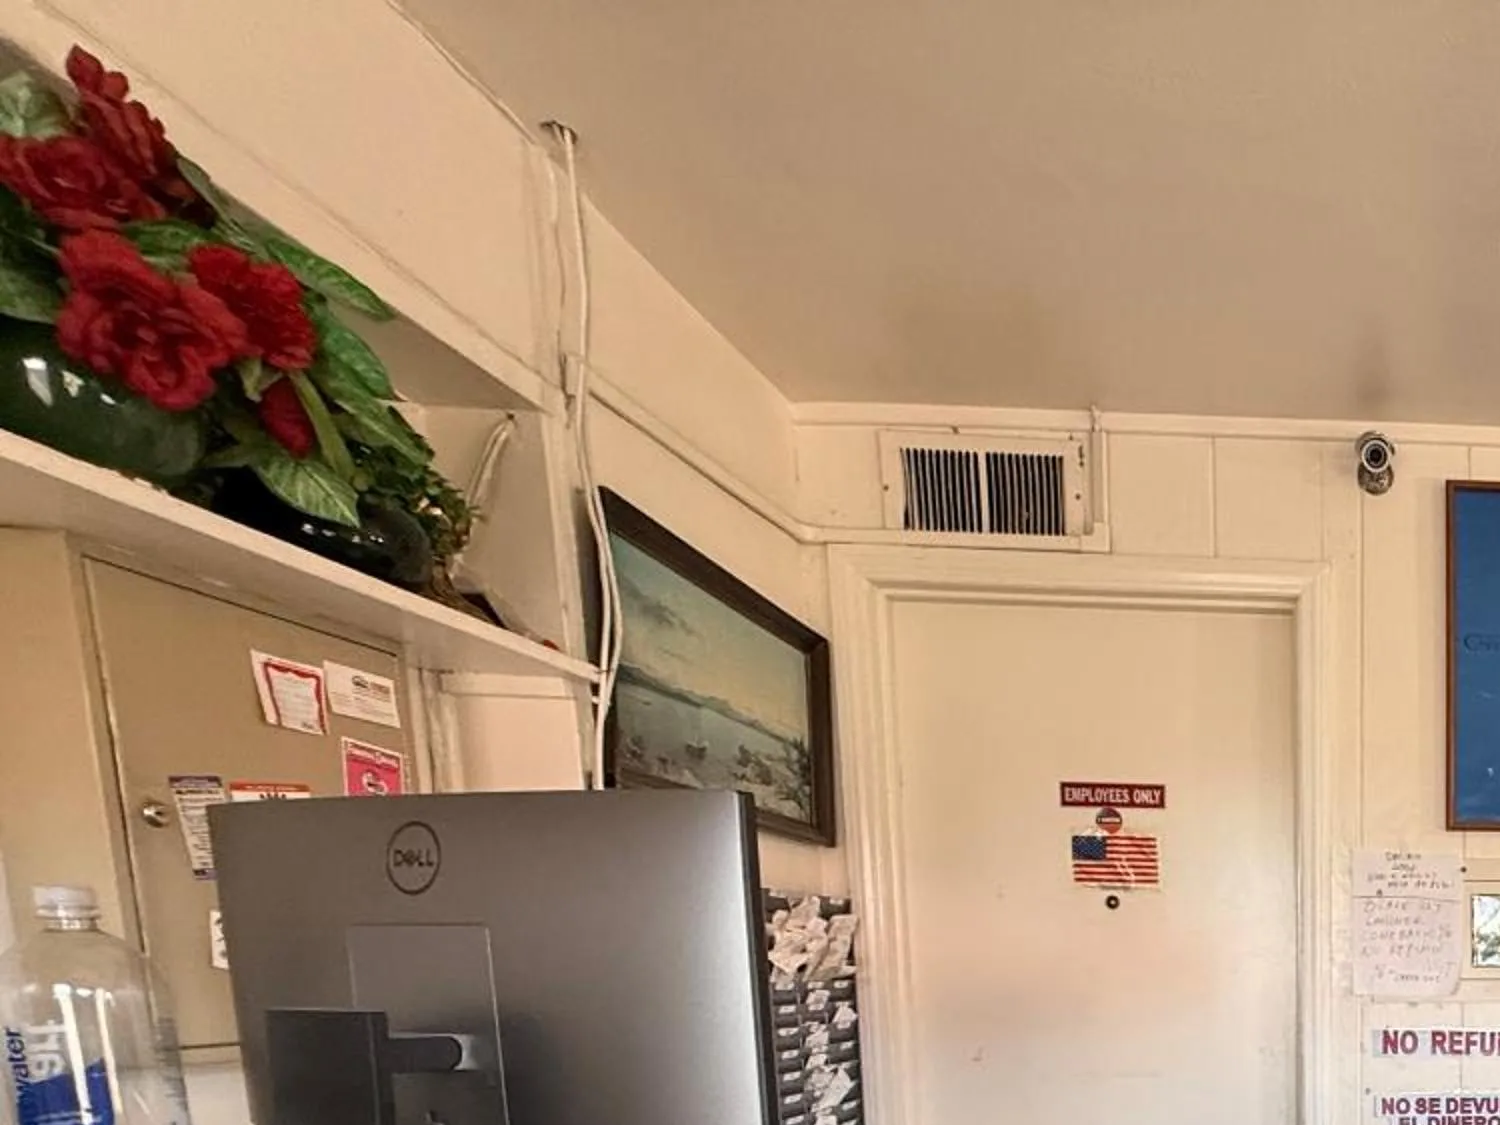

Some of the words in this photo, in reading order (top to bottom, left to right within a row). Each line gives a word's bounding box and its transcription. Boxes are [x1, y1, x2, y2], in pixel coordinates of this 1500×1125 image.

[1064, 787, 1130, 803] EMPLOYEES
[1133, 788, 1161, 804] ONLY
[393, 848, 434, 867] DELL
[1381, 1030, 1419, 1055] NO
[1381, 1098, 1410, 1115] NO
[1415, 1097, 1441, 1114] SE
